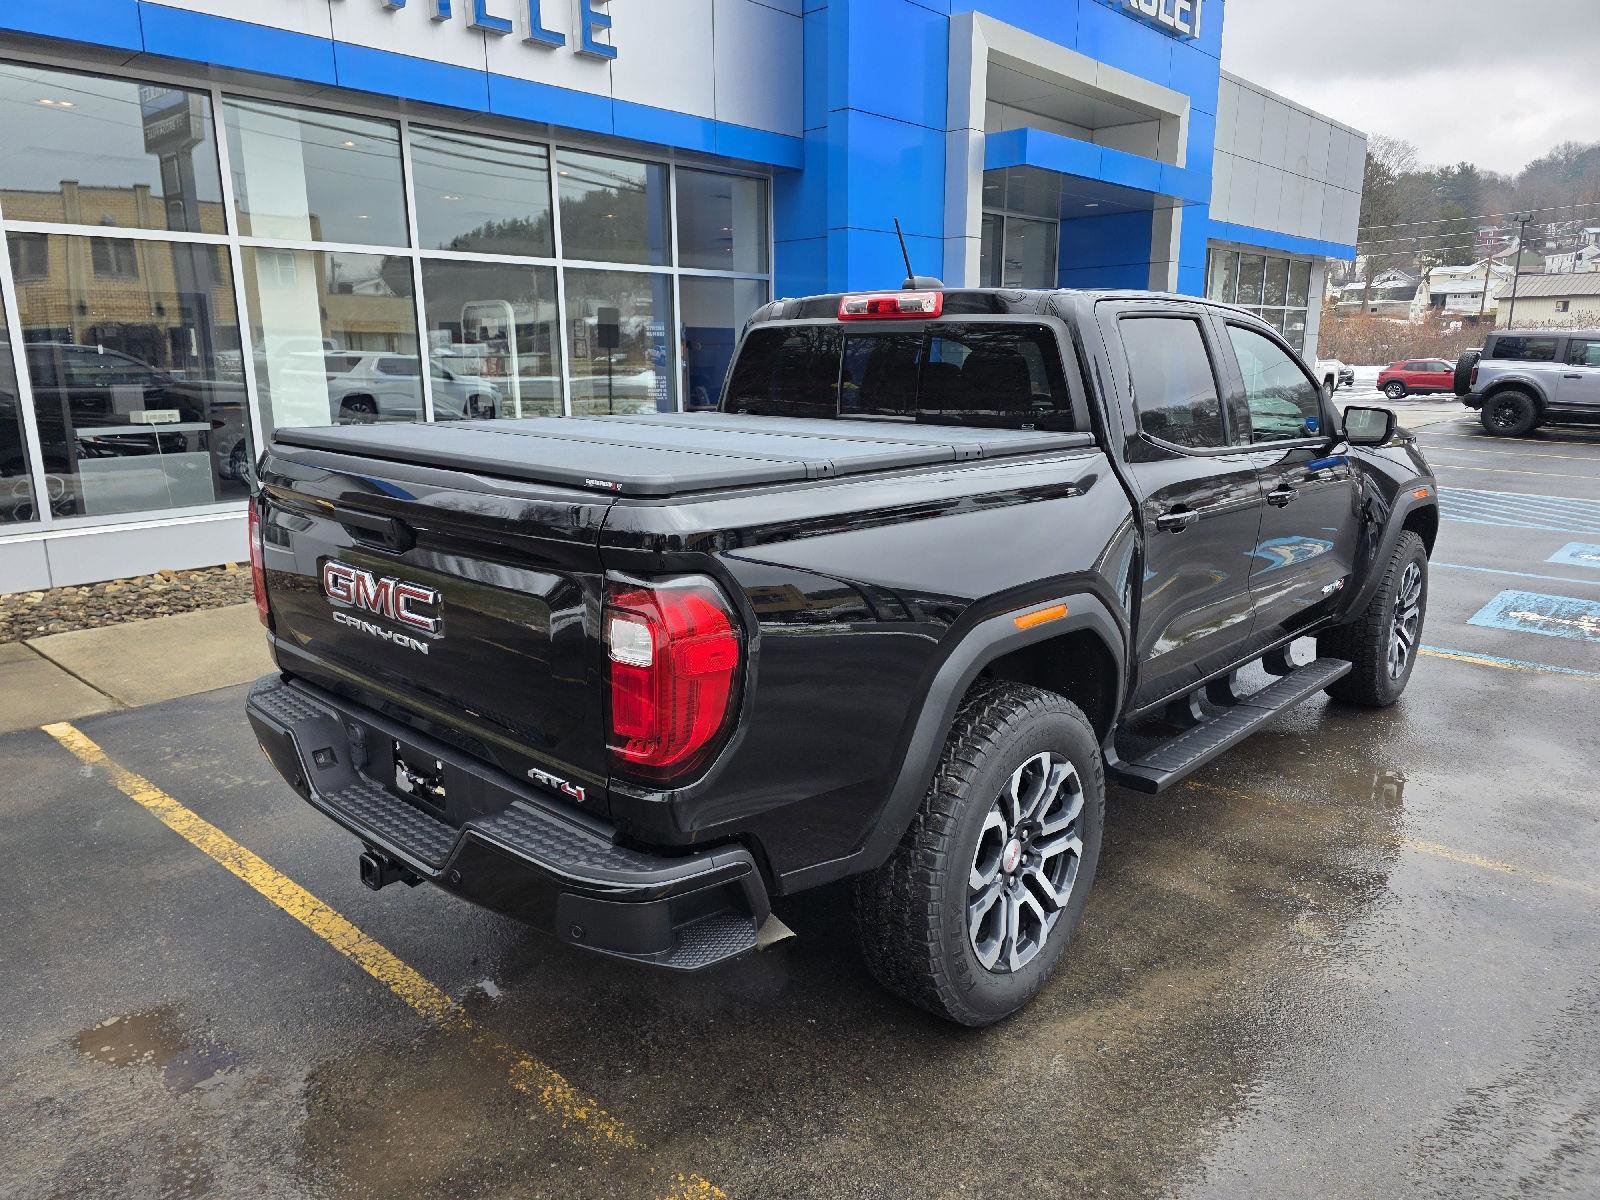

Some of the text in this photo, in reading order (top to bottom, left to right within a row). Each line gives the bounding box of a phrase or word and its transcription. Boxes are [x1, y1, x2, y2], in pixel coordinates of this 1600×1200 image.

[323, 560, 443, 637] GMC
[332, 611, 430, 655] CANYON
[527, 768, 586, 802] AT4
